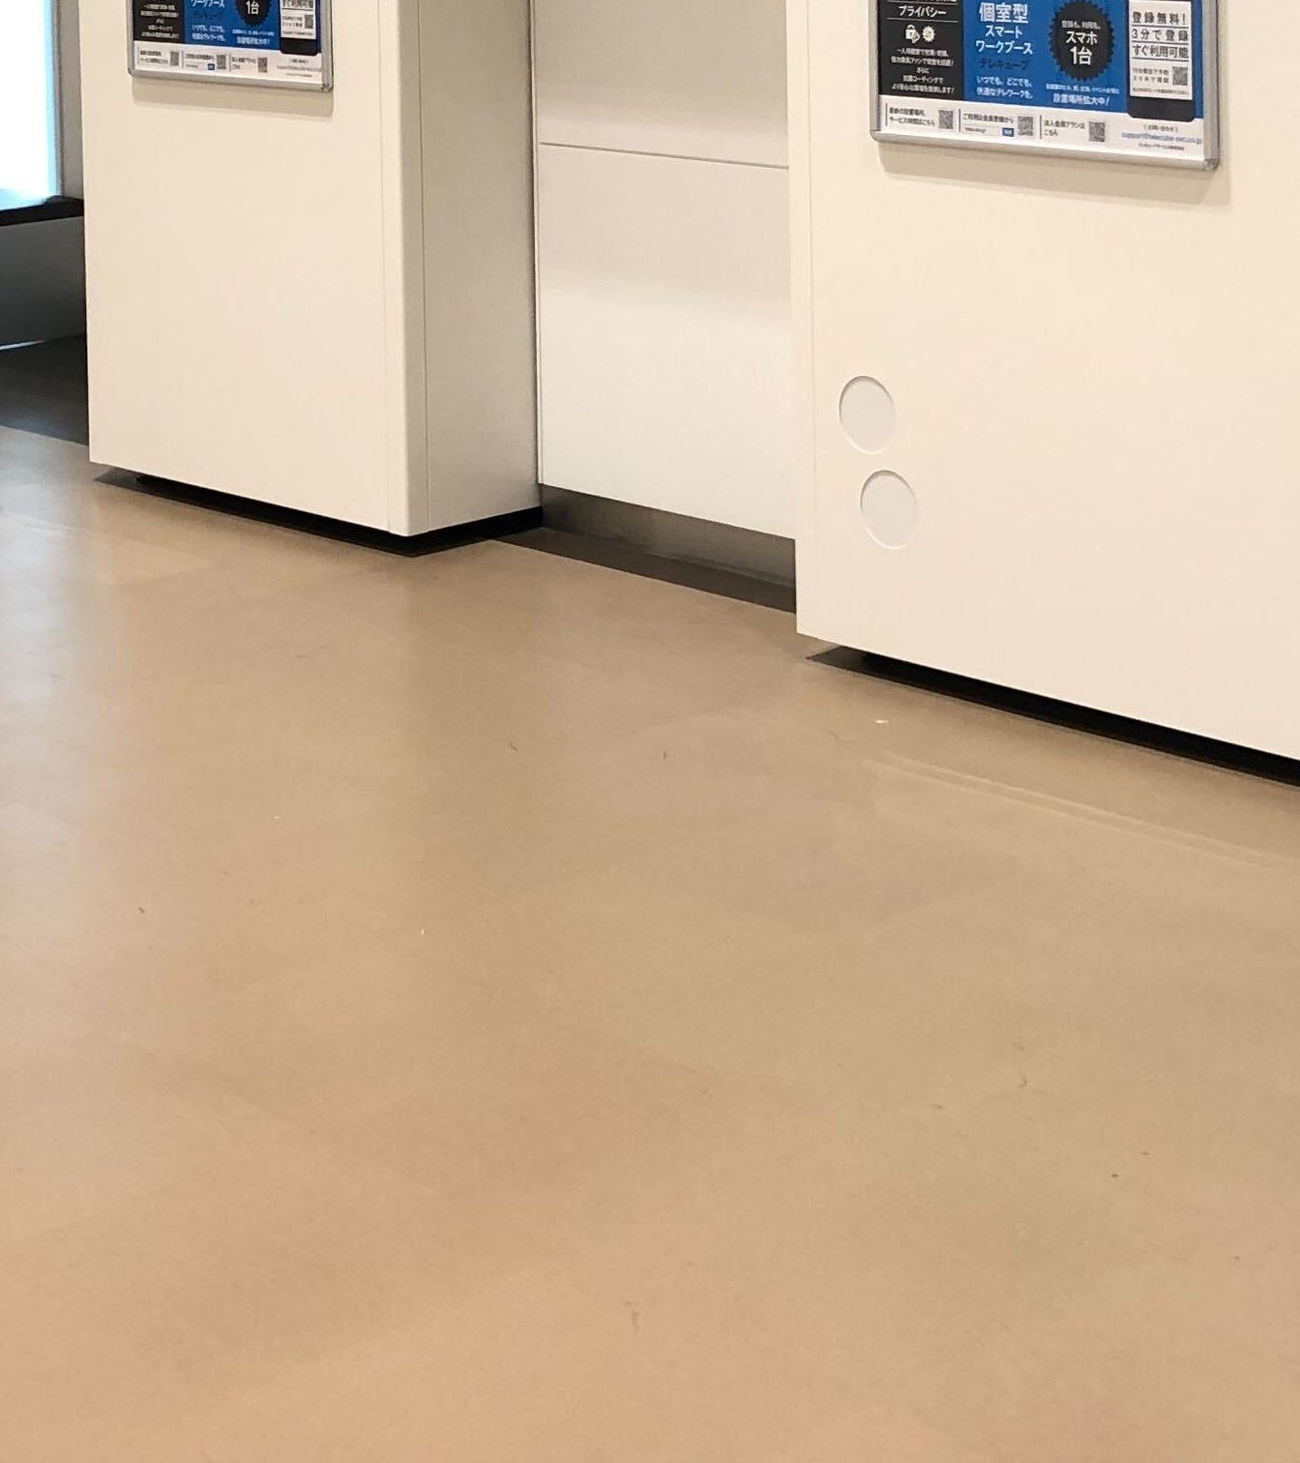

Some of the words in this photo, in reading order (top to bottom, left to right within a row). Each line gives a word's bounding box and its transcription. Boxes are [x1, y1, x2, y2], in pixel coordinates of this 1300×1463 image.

[246, 2, 259, 15] 1台
[898, 5, 947, 18] プライバシー
[979, 2, 1029, 24] 個室型
[985, 24, 1023, 39] スマート
[1066, 31, 1098, 45] スマホ
[1132, 29, 1188, 41] 3分で登録
[975, 40, 1033, 54] ワークブース
[1132, 45, 1189, 58] すぐ利用可能
[1070, 46, 1092, 65] 1台
